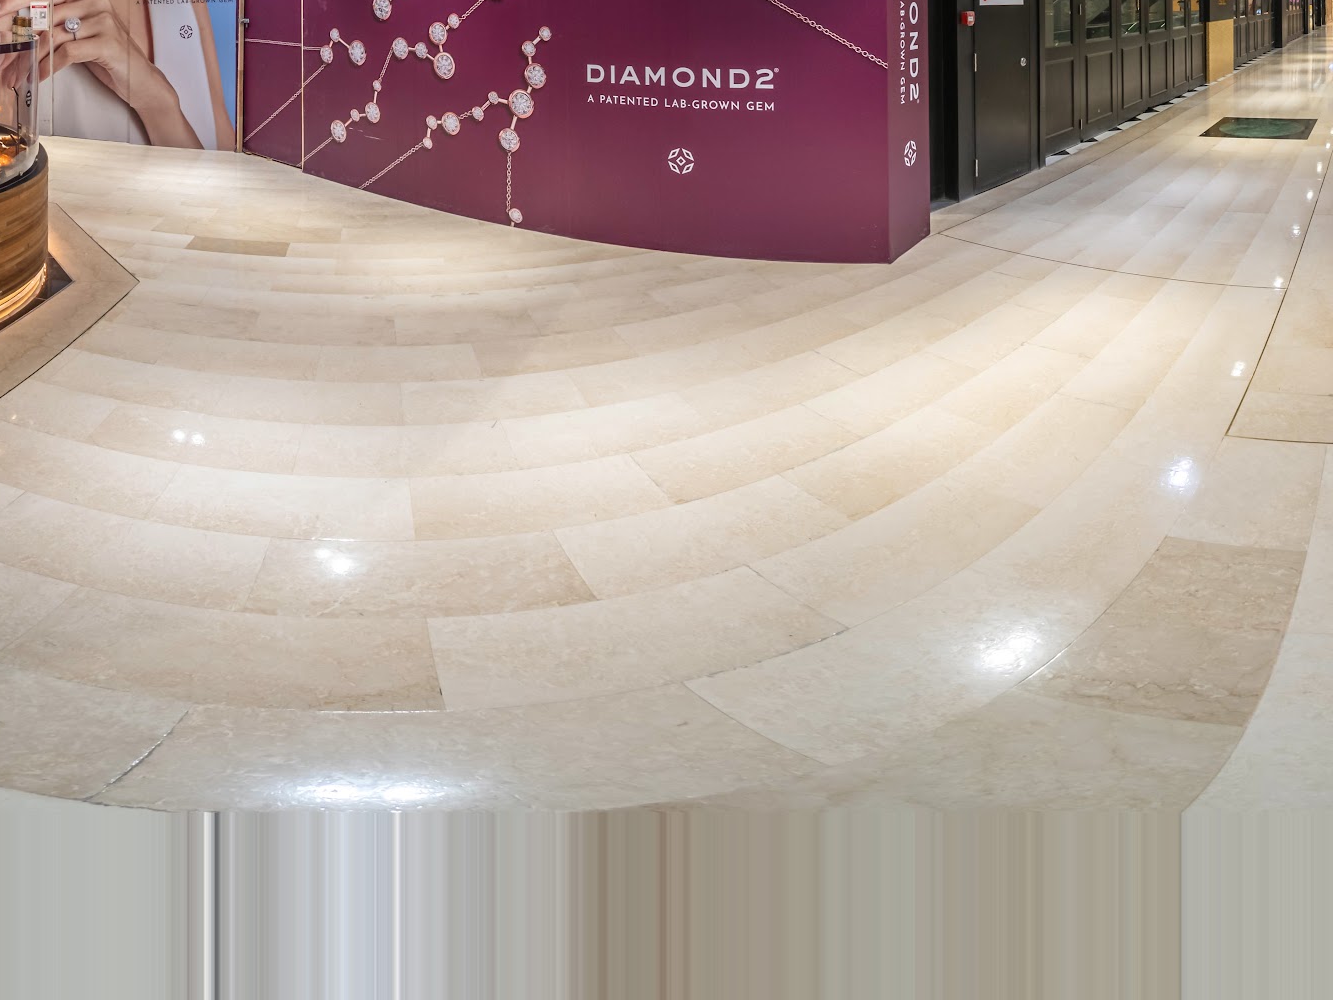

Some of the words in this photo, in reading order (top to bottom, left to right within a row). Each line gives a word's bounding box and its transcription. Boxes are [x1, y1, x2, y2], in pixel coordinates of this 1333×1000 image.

[587, 94, 595, 103] A
[599, 94, 659, 107] PATENTED
[664, 98, 740, 111] LAB-GROWN
[746, 101, 775, 112] GEM
